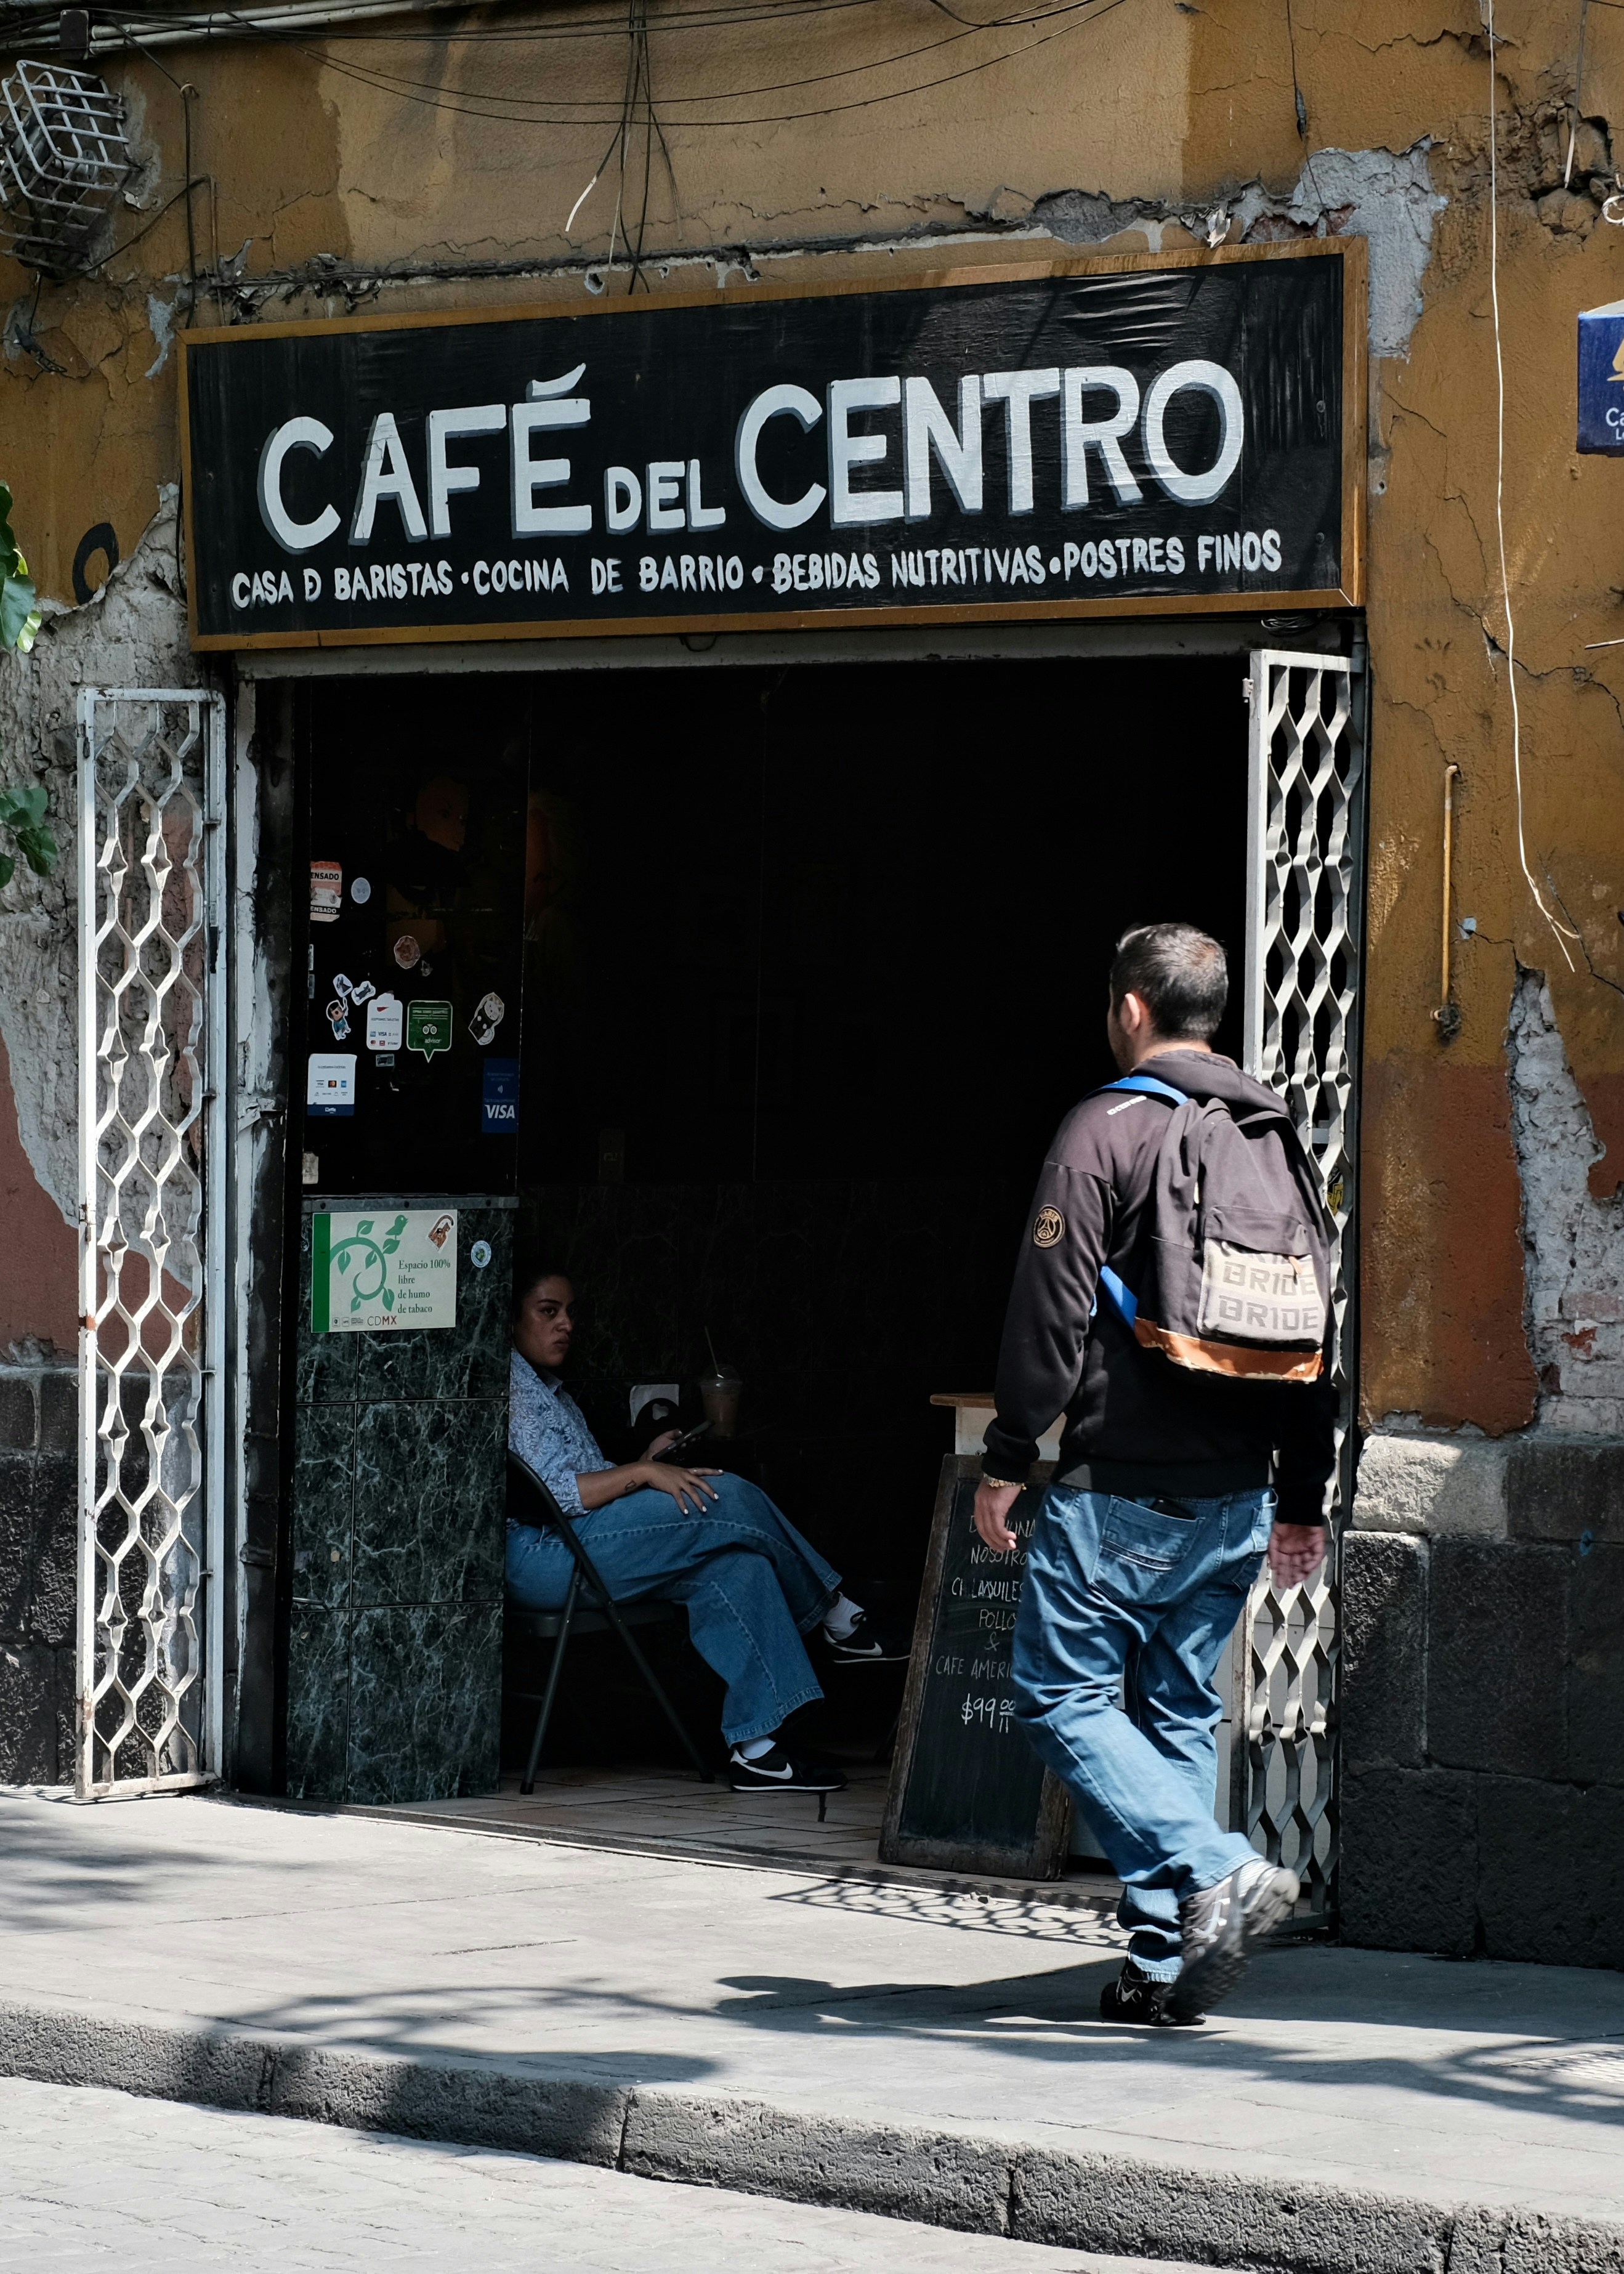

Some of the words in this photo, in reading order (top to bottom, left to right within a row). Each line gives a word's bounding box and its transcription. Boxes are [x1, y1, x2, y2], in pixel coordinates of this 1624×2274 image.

[257, 363, 592, 554] CAFÉ
[604, 459, 725, 534] DEL
[735, 359, 1245, 530] CENTRO
[232, 570, 294, 610] CASA
[334, 560, 453, 601] BARISTAS
[472, 557, 569, 596] COCINA
[591, 557, 623, 595] DE
[639, 554, 744, 592] BARRIO
[770, 552, 881, 594] BEBIDAS
[891, 545, 1046, 588] NUTRITIVAS
[1064, 536, 1186, 581] POSTRES
[1197, 528, 1282, 573] FINOS
[484, 1104, 515, 1119] VISA
[398, 1260, 428, 1273] Espacio
[430, 1259, 450, 1269] 100%
[398, 1274, 415, 1284] libre
[1223, 1261, 1317, 1296] BRIDE
[397, 1289, 407, 1299] de
[408, 1289, 430, 1299] humo
[397, 1303, 407, 1314] de
[408, 1303, 433, 1314] tabaco
[1218, 1295, 1319, 1330] BRIDE
[367, 1315, 397, 1327] CDMX
[978, 1608, 1017, 1631] POLLO
[935, 1655, 964, 1676] CAFE
